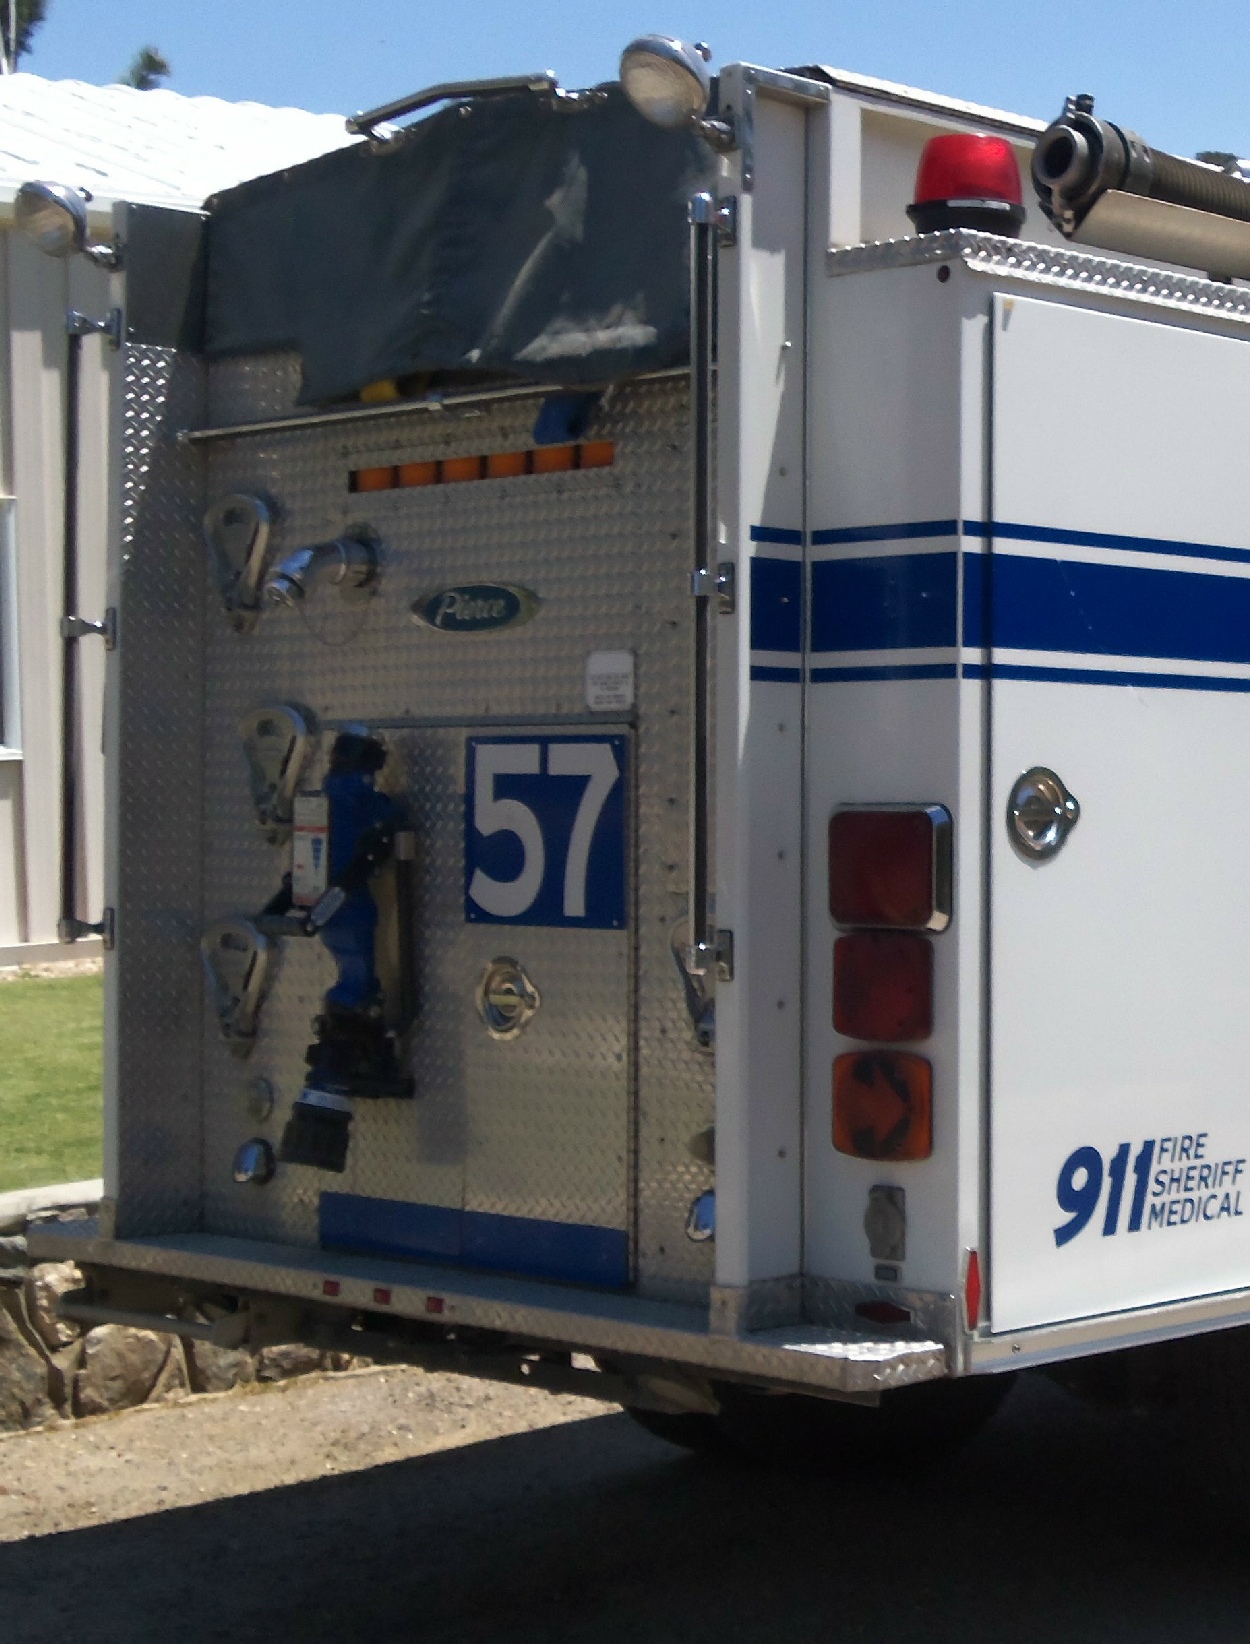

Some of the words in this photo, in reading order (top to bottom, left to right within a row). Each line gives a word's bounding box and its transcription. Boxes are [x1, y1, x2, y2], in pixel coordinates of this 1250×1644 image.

[434, 591, 506, 626] Pierce
[469, 743, 620, 917] 57
[1157, 1132, 1208, 1164] FIRE
[1053, 1139, 1156, 1249] 911
[1152, 1158, 1247, 1198] SHERIFF
[1147, 1190, 1244, 1231] MEDICAL
